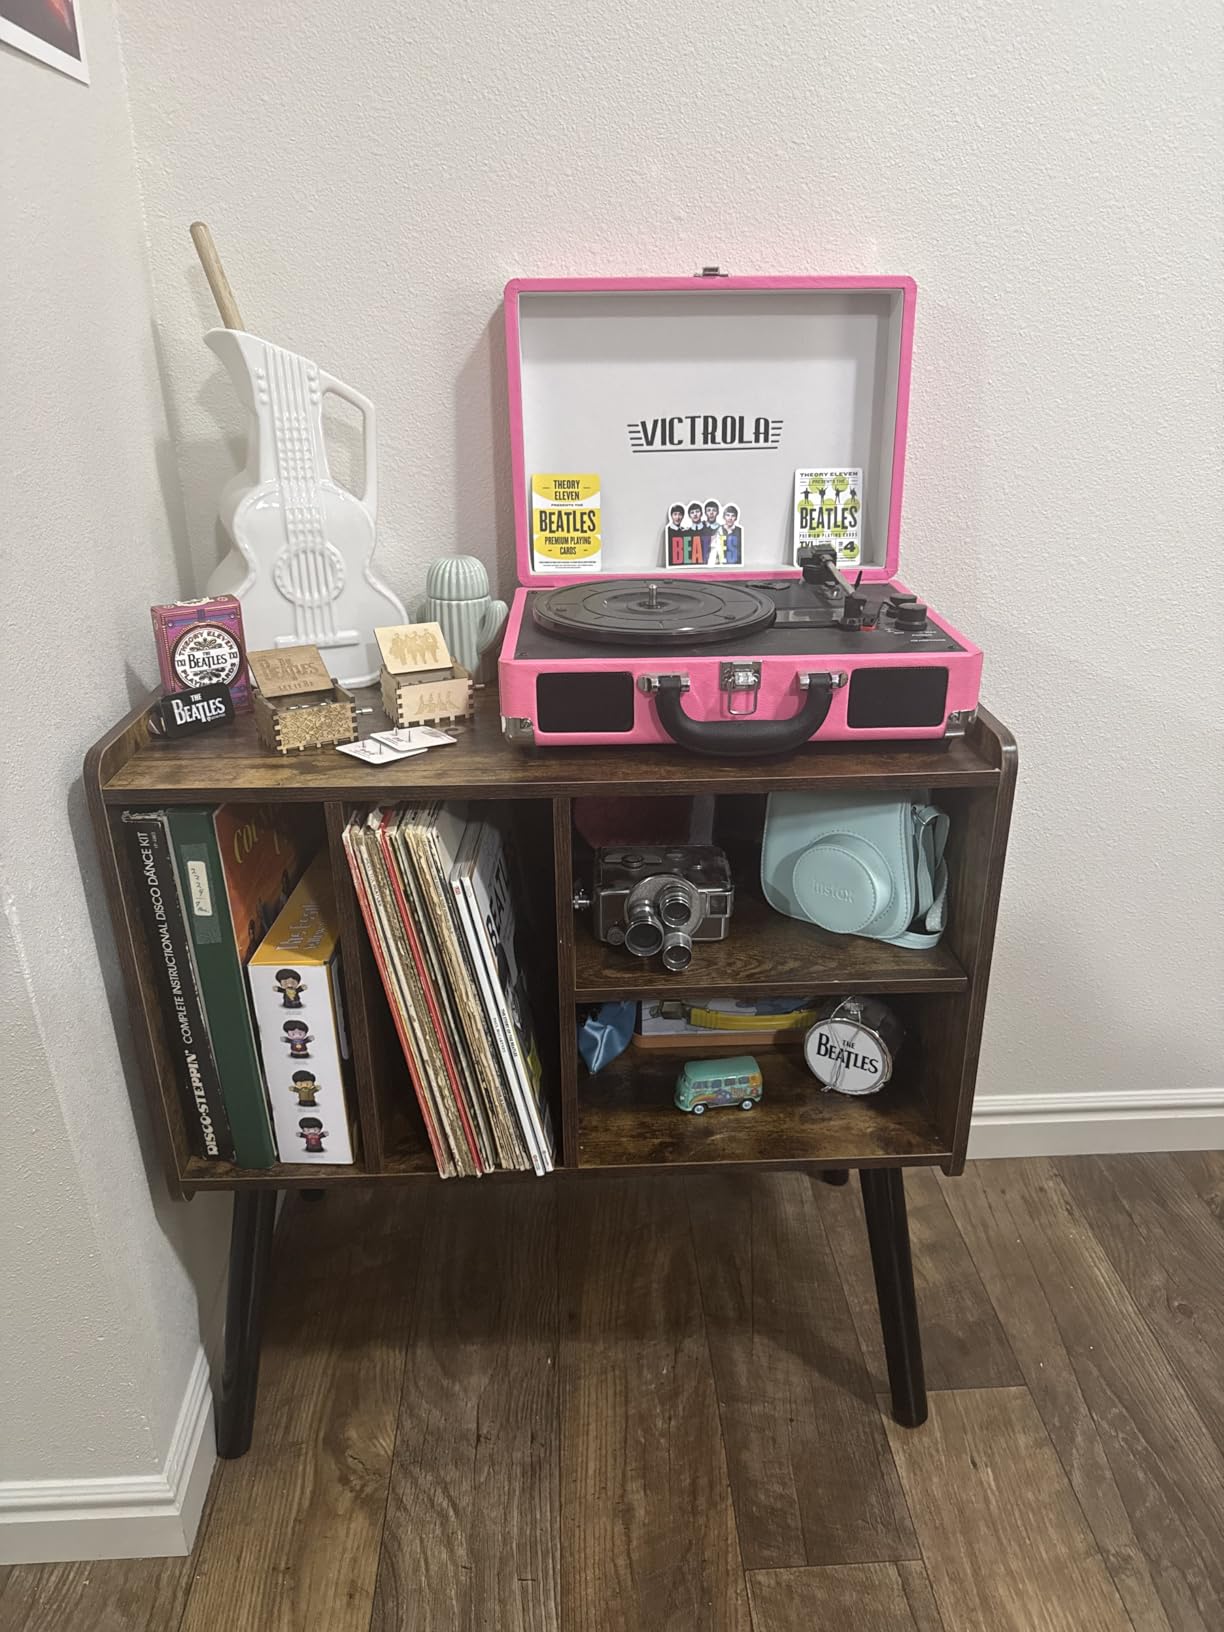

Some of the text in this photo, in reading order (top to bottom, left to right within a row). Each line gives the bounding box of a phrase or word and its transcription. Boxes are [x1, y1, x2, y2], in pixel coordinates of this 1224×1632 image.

[640, 415, 770, 446] VICTROLA
[553, 479, 580, 489] THEORY
[554, 491, 580, 501] ELEVEN
[539, 510, 596, 533] BEATLES
[800, 505, 858, 530] BEATLES
[544, 536, 592, 545] PREMIUM PLAYING
[559, 546, 577, 555] CARDS
[672, 535, 738, 565] BEATES
[843, 541, 856, 552] 4
[179, 631, 234, 656] THEORY ELEVEN
[188, 652, 228, 669] BEATLES
[190, 693, 202, 702] THE
[171, 698, 225, 725] BEATLES
[137, 831, 150, 846] KIT
[141, 848, 159, 886] DANCE
[149, 888, 166, 920] DISCO
[158, 922, 183, 995] INSTRUCTIONAL
[174, 996, 193, 1044] COMPLETE
[816, 1032, 879, 1074] BEATLES
[842, 1040, 855, 1049] THE
